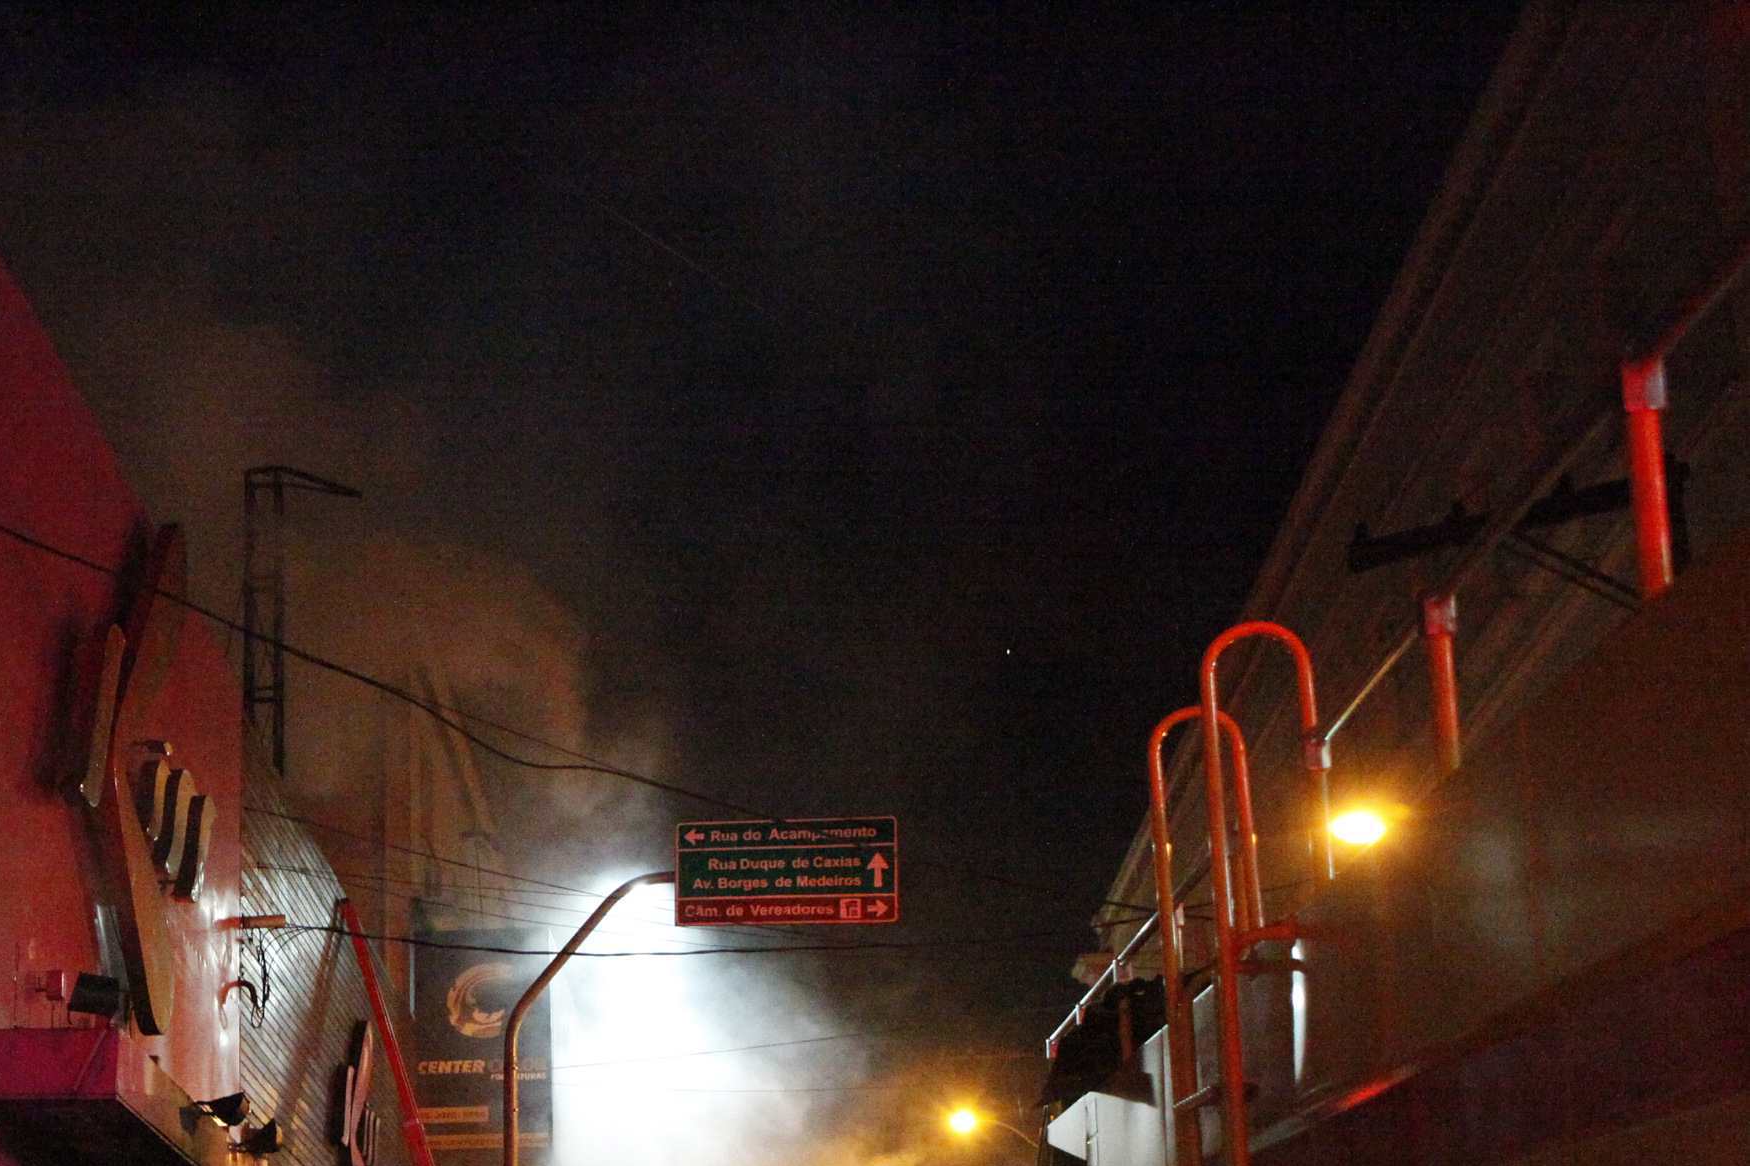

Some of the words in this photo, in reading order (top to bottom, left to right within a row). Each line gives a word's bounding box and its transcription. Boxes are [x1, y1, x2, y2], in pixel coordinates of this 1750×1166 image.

[710, 829, 738, 842] Rua
[742, 828, 763, 841] do
[708, 856, 737, 871] Rua
[739, 857, 787, 872] Duque
[791, 855, 811, 870] de
[812, 854, 863, 869] Caxias
[692, 877, 715, 890] Av.
[717, 876, 769, 892] Borges
[774, 875, 793, 888] de
[796, 873, 863, 889] Medeiros
[725, 904, 745, 917] de
[749, 903, 835, 917] Vereadores
[417, 1058, 486, 1074] CENTER
